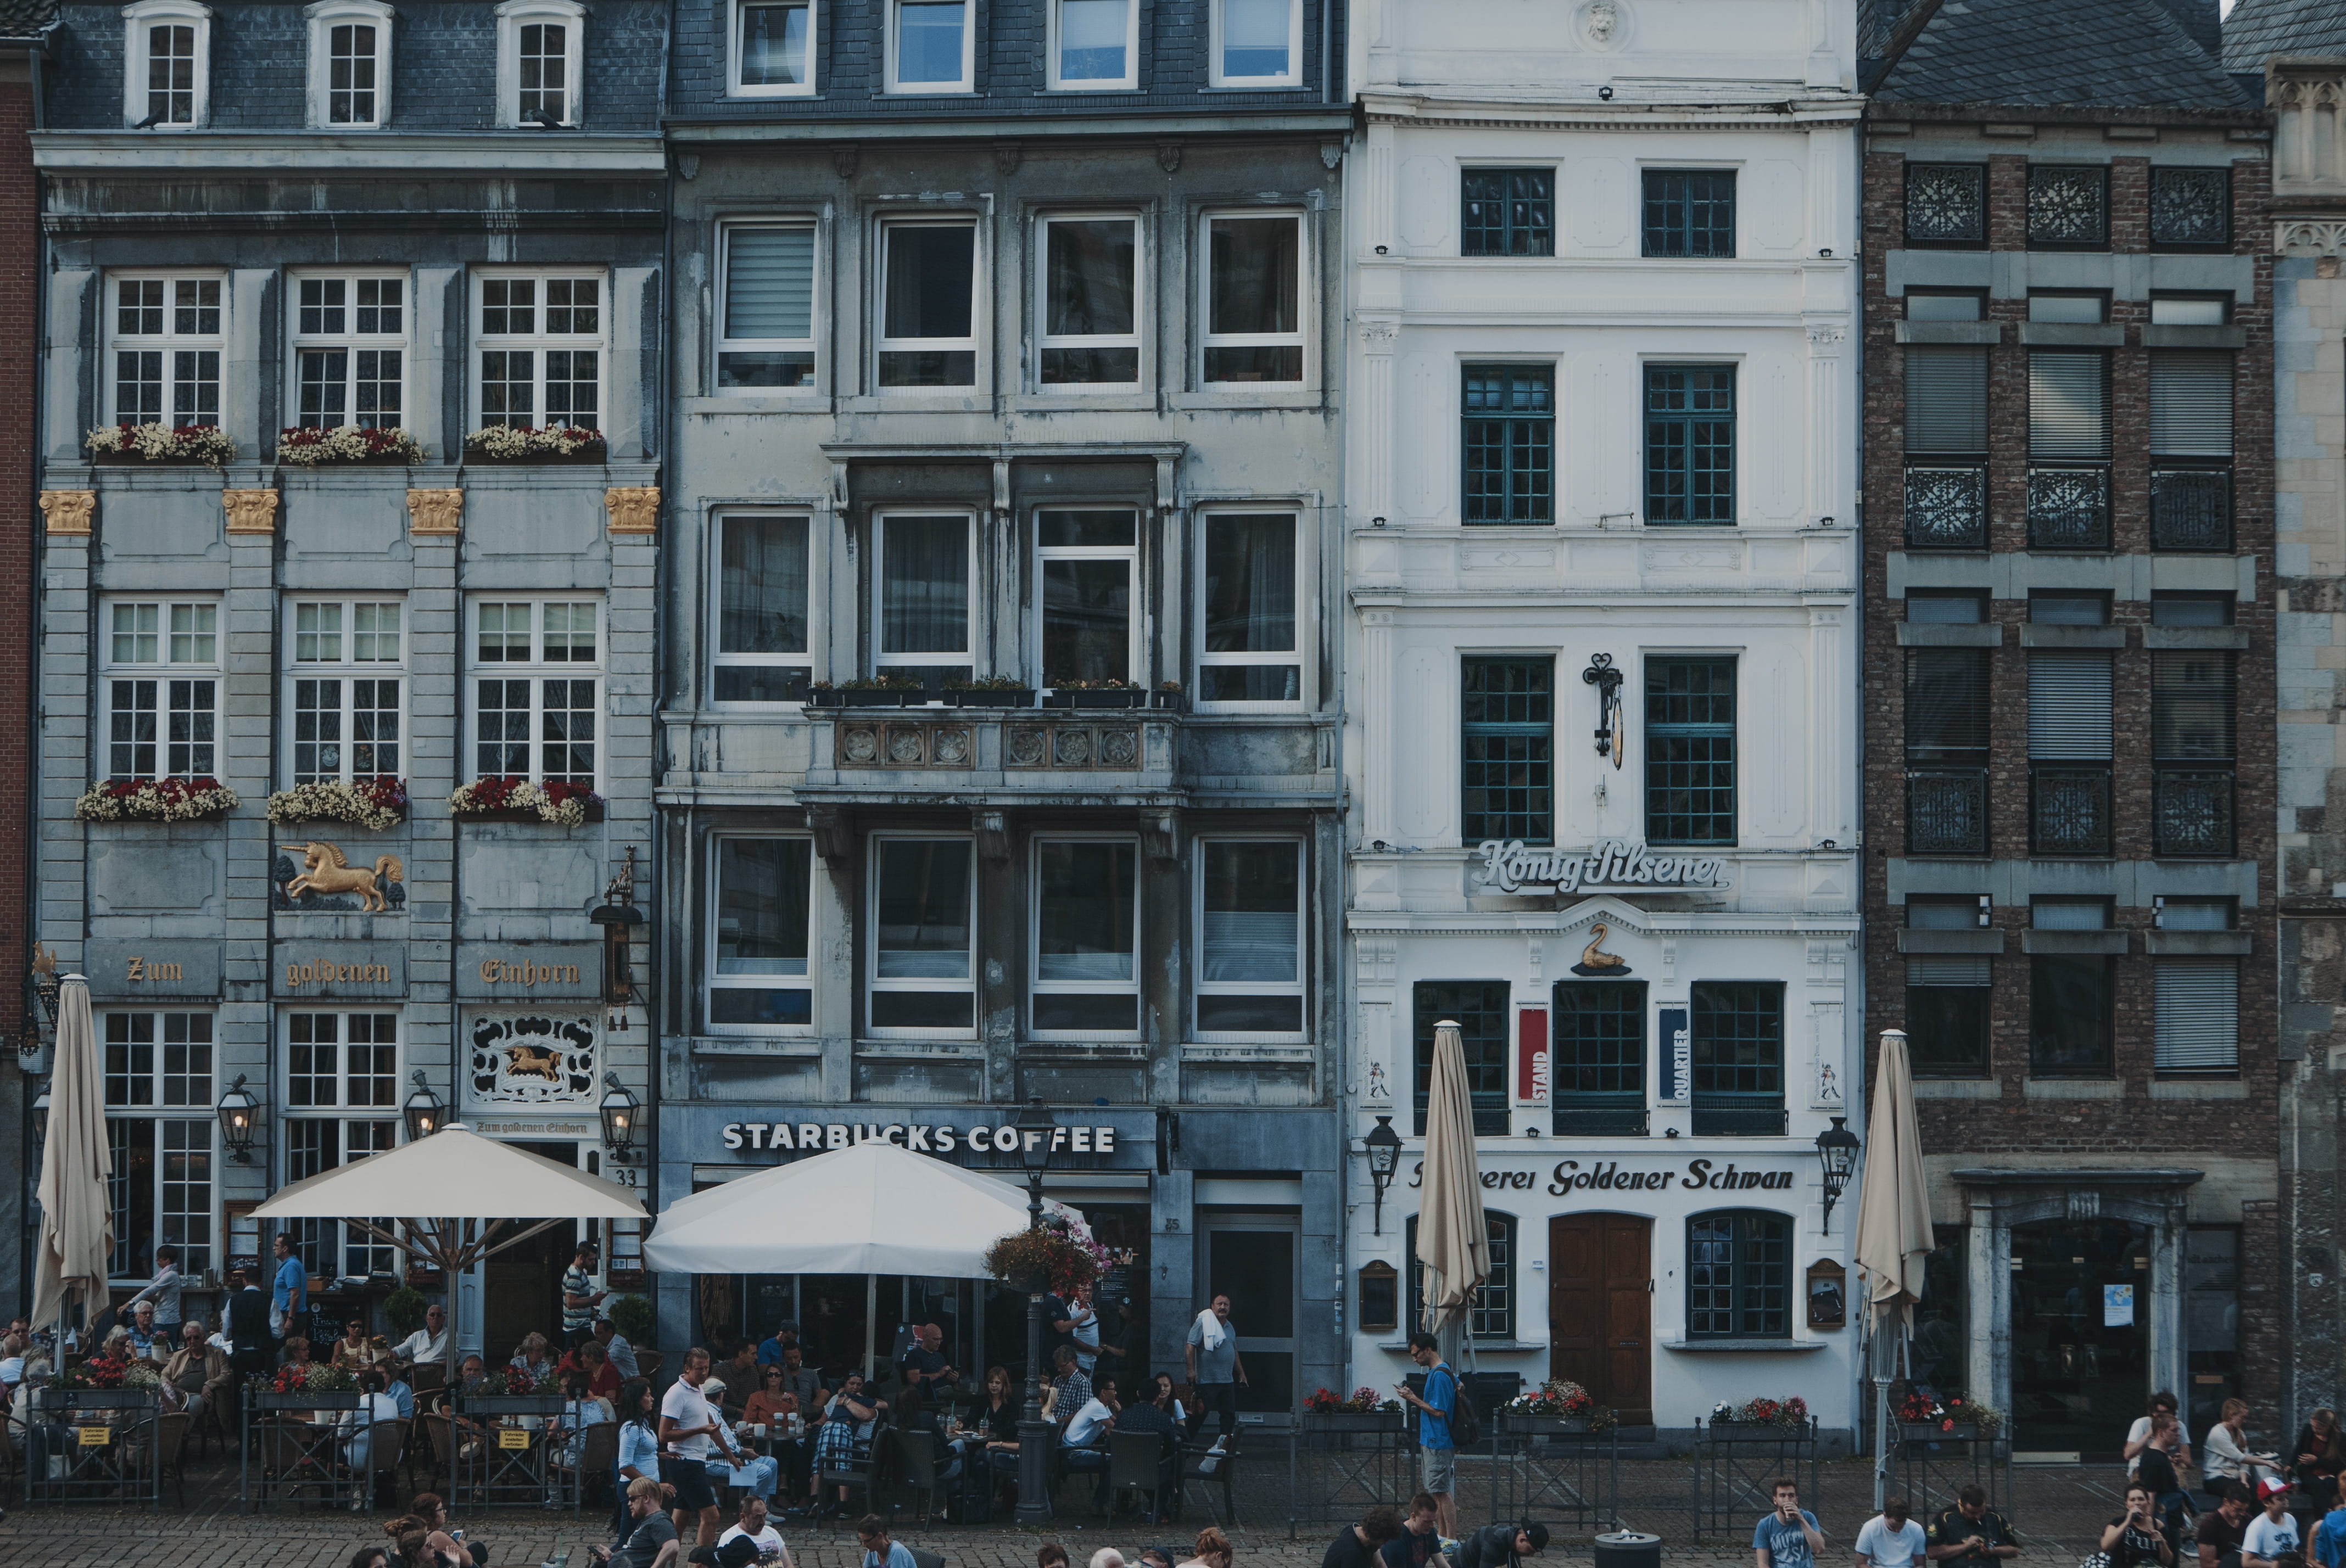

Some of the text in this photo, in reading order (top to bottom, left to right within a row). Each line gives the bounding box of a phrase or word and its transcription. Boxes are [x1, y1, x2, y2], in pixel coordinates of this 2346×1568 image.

[126, 956, 580, 987] Zum goldenen Einhorn
[1532, 1051, 1547, 1099] STAND
[1674, 1029, 1688, 1099] QUARTIER
[476, 1122, 587, 1134] Zum goldenen Einhorn
[967, 1125, 1115, 1152] COFFEE
[616, 1169, 636, 1186] 33
[1548, 1160, 1675, 1196] Goldener
[1682, 1159, 1793, 1189] Schwan
